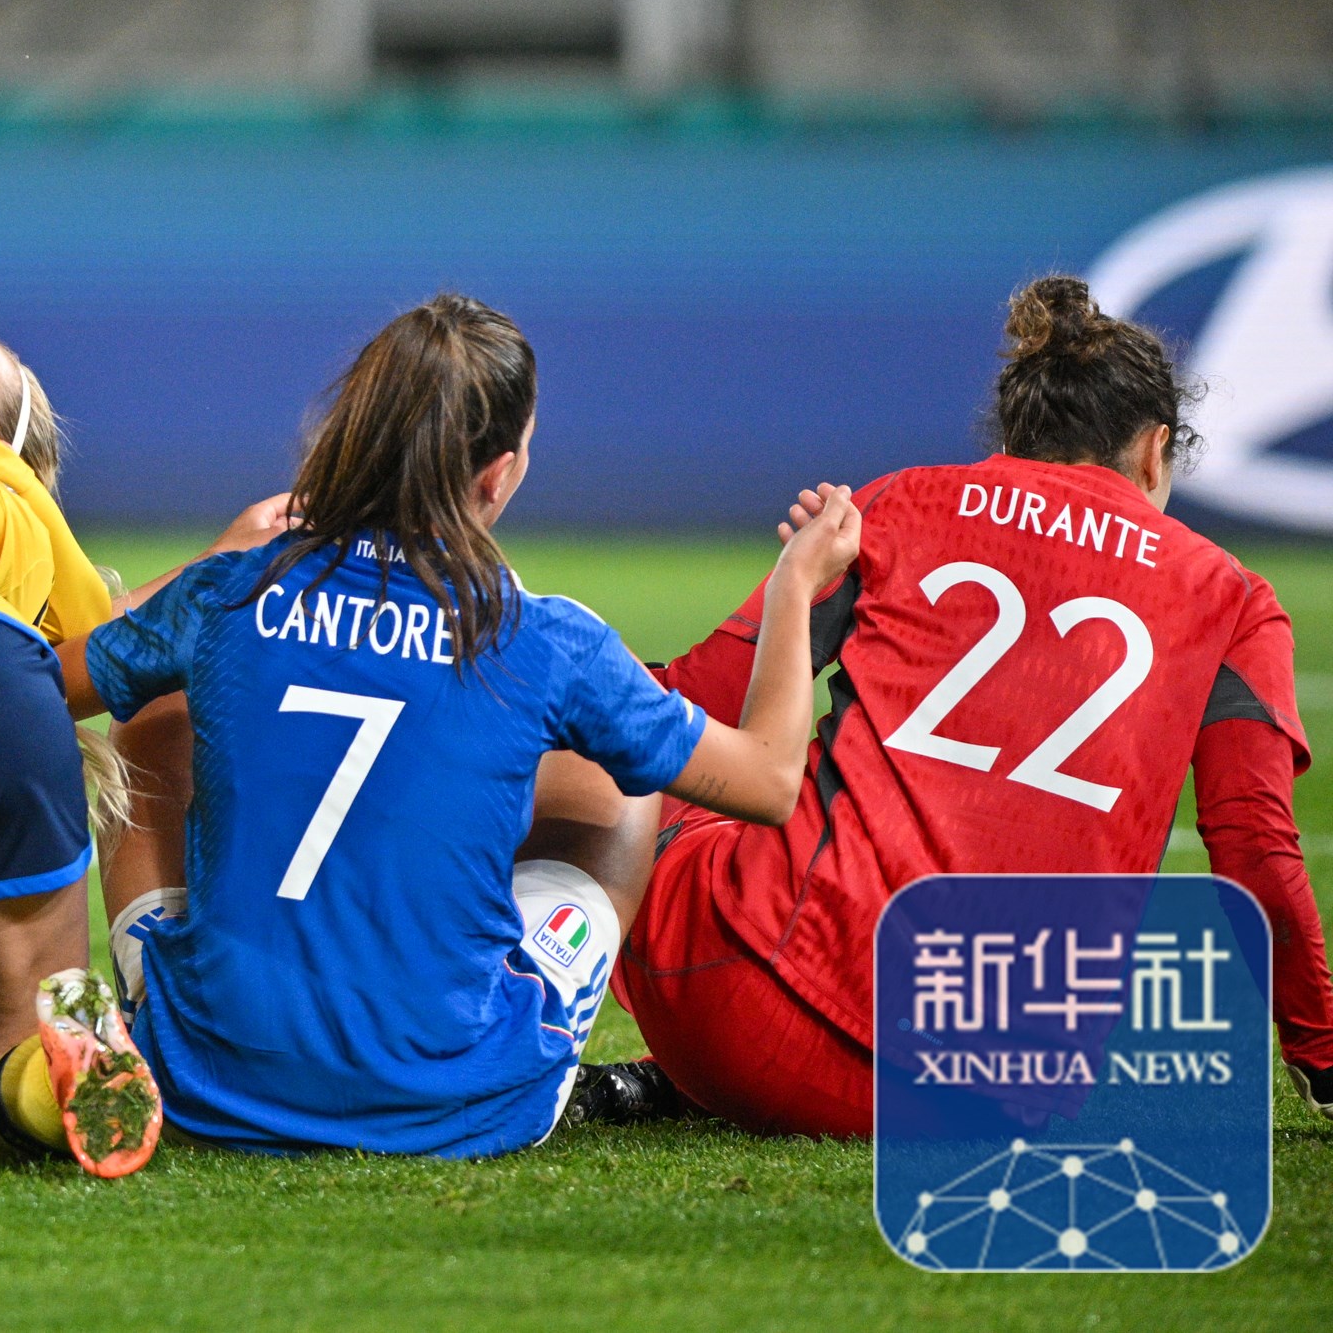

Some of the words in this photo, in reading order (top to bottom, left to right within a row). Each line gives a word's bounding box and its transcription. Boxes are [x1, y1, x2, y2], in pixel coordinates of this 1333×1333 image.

[355, 539, 406, 563] ITAIA
[959, 483, 1162, 569] DURANTE
[255, 583, 459, 665] CANTORE
[882, 561, 1156, 813] 22
[275, 684, 406, 901] 7
[540, 932, 572, 963] ITALIA
